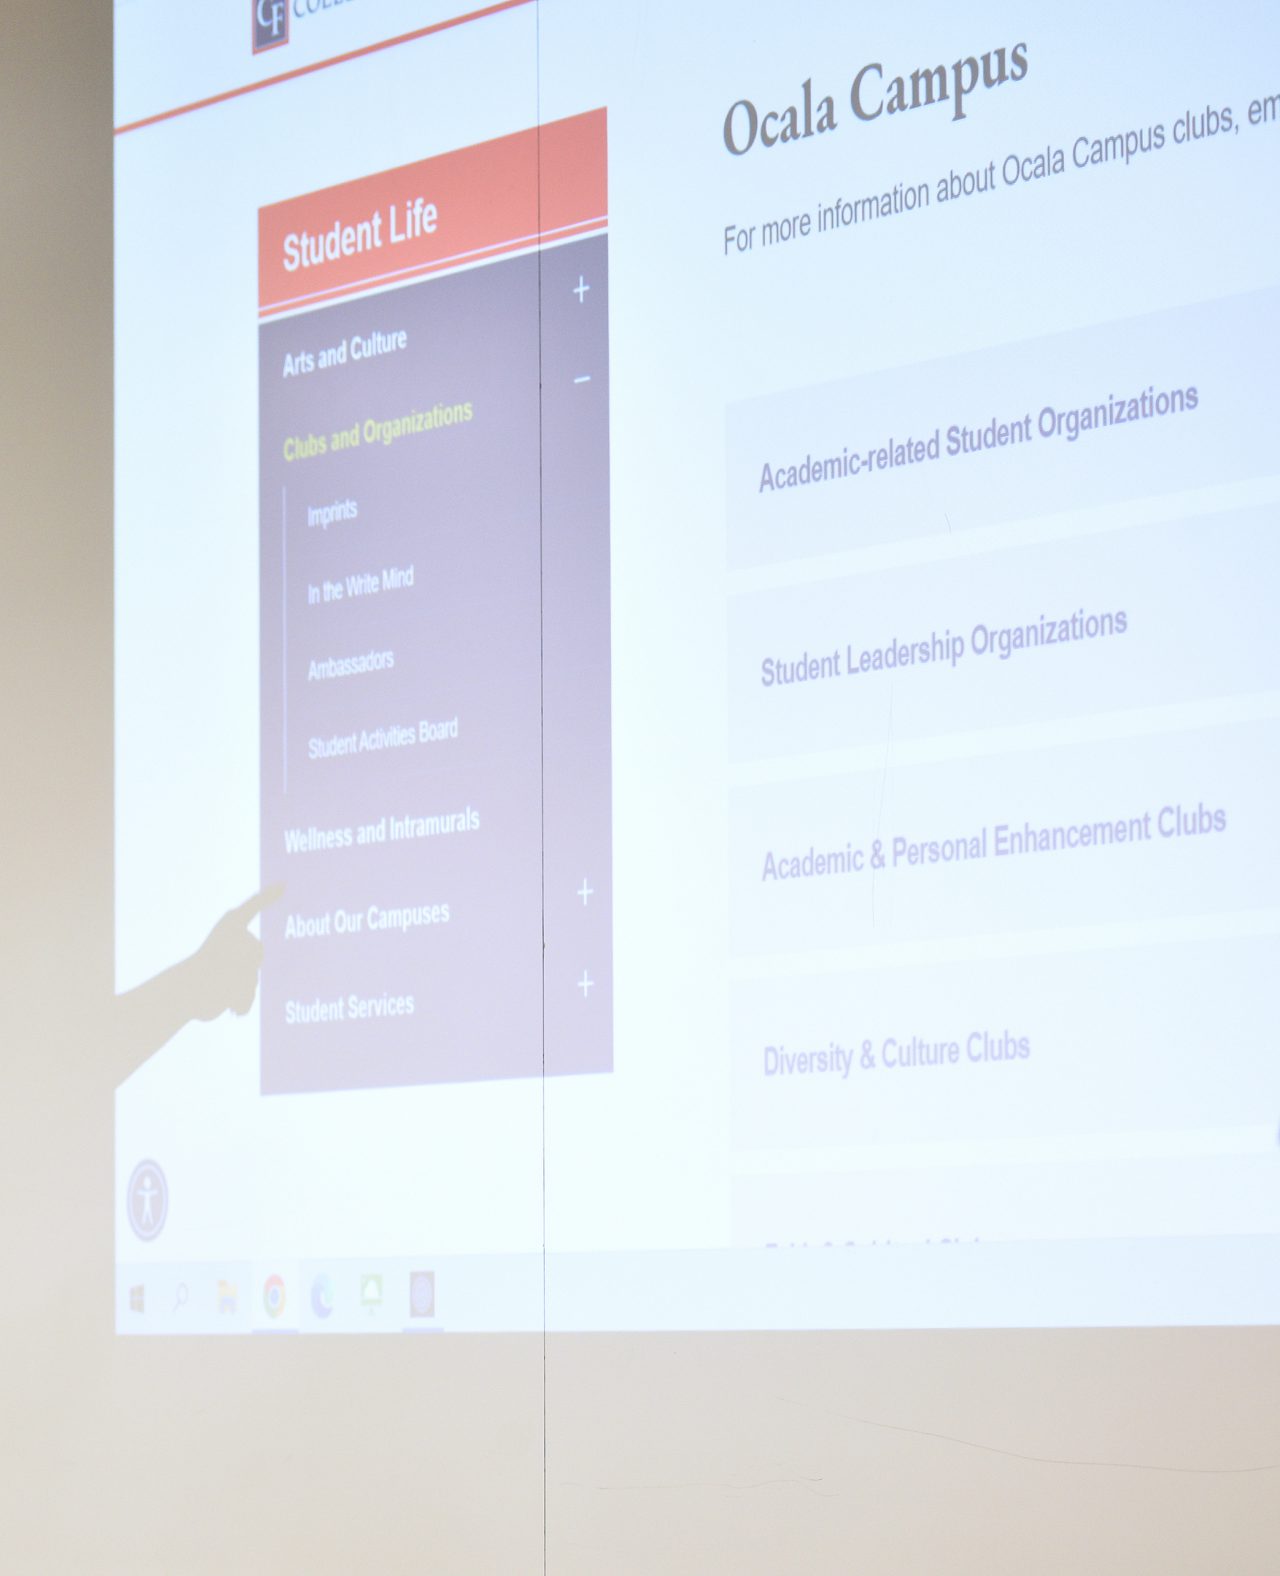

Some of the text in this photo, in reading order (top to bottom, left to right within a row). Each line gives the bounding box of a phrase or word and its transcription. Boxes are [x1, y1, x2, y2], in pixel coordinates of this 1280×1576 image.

[722, 41, 1029, 157] Ocala Campus
[723, 224, 756, 257] For
[761, 210, 812, 249] more
[817, 181, 931, 233] information
[935, 162, 996, 205] about
[1002, 145, 1066, 187] Ocala
[1071, 123, 1166, 169] Campus
[1172, 100, 1240, 145] clubs,
[283, 197, 438, 272] Student Life
[282, 329, 408, 378] Arts and Culture
[283, 401, 474, 463] Clubs and Organizations
[758, 385, 1200, 494] Academic-related Student Organizations
[307, 498, 358, 530] Imprints
[308, 564, 414, 605] In the Write Mind
[308, 650, 395, 682] Ambassadors
[760, 608, 1128, 688] Student Leadership Organizations
[308, 717, 459, 760] Student Activities Board
[284, 806, 481, 854] Wellness and Intramurals
[762, 802, 1227, 882] Academic & Personal Enhancement Clubs
[284, 902, 450, 940] About Our Campuses
[285, 992, 415, 1025] Student Services
[763, 1029, 1031, 1079] Diversity & Culture Clubs
